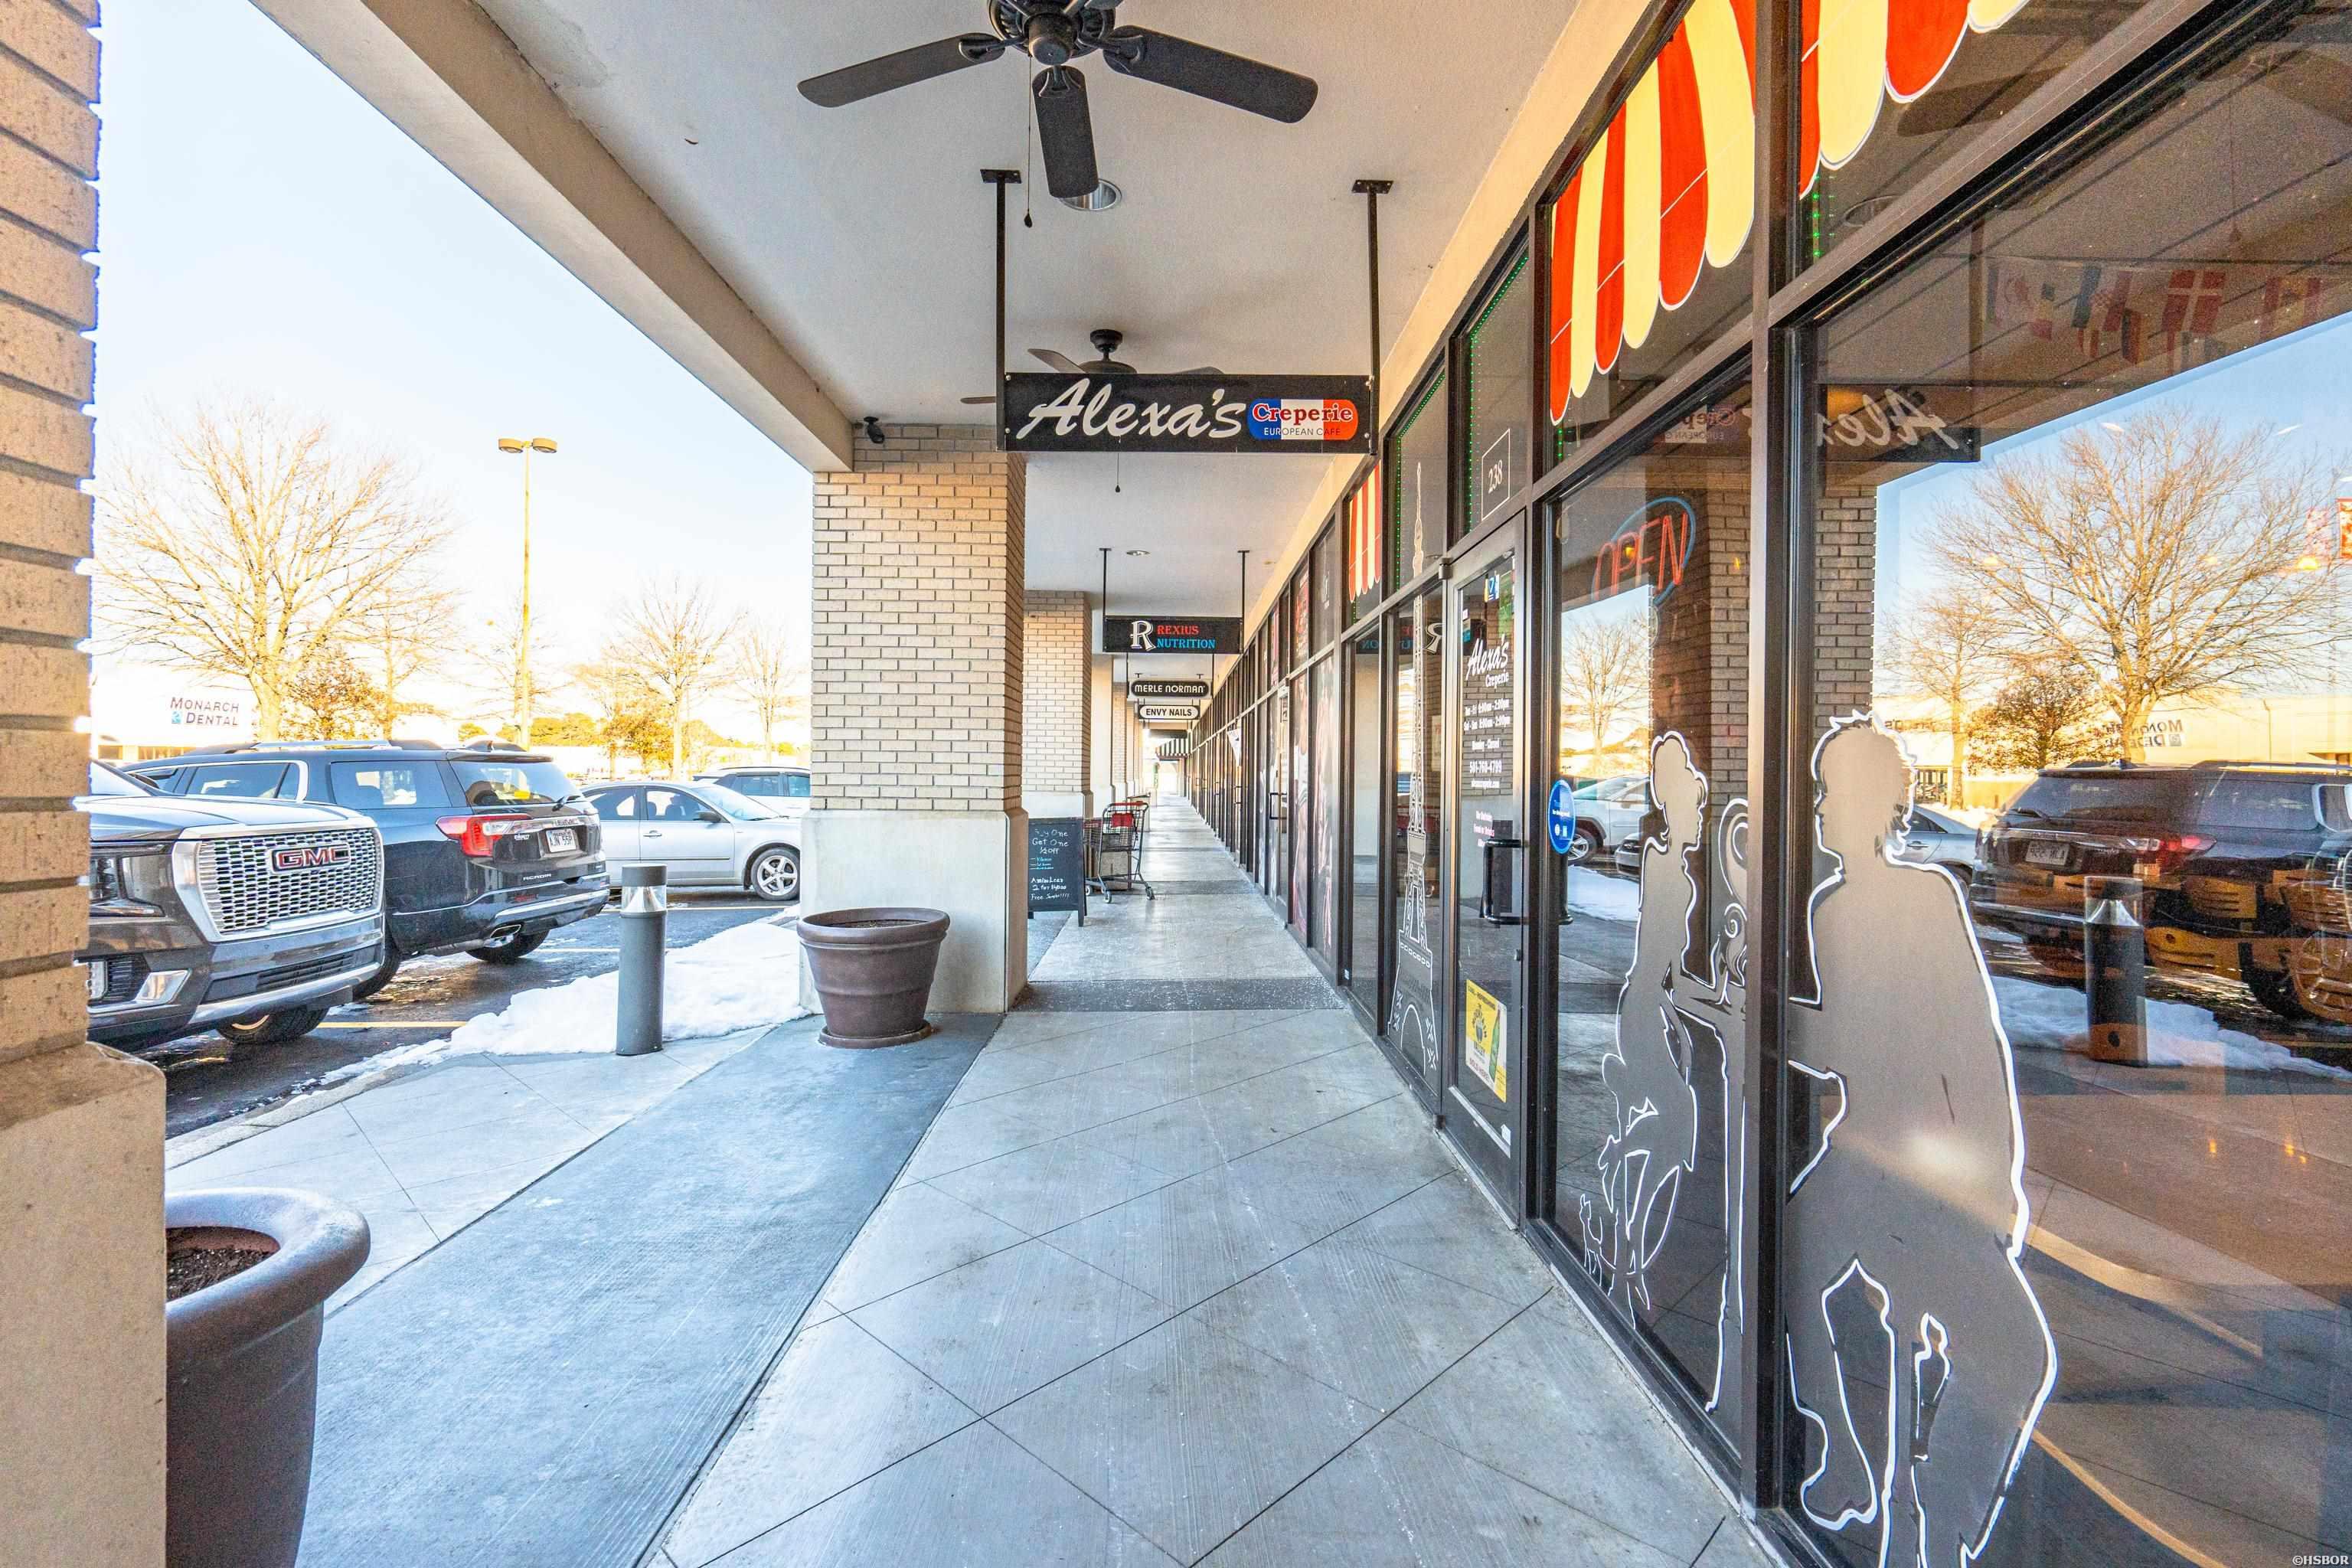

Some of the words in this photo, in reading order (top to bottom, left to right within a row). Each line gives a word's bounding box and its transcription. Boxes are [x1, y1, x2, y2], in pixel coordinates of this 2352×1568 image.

[1017, 377, 1246, 439] Alexa's
[1253, 403, 1353, 426] Creperie
[1264, 427, 1314, 436] EUROPEAN
[1488, 459, 1503, 494] 238
[1130, 620, 1156, 652] R
[1157, 625, 1200, 635] REXIUS
[1156, 638, 1216, 648] NUTRITION
[1465, 634, 1510, 681] Alexa's
[1135, 684, 1162, 693] MERLE
[1165, 684, 1204, 694] NORMAN
[1485, 669, 1509, 689] Creperie
[170, 697, 240, 713] MONARCH
[186, 712, 239, 726] DENTAL
[276, 846, 351, 869] GMC
